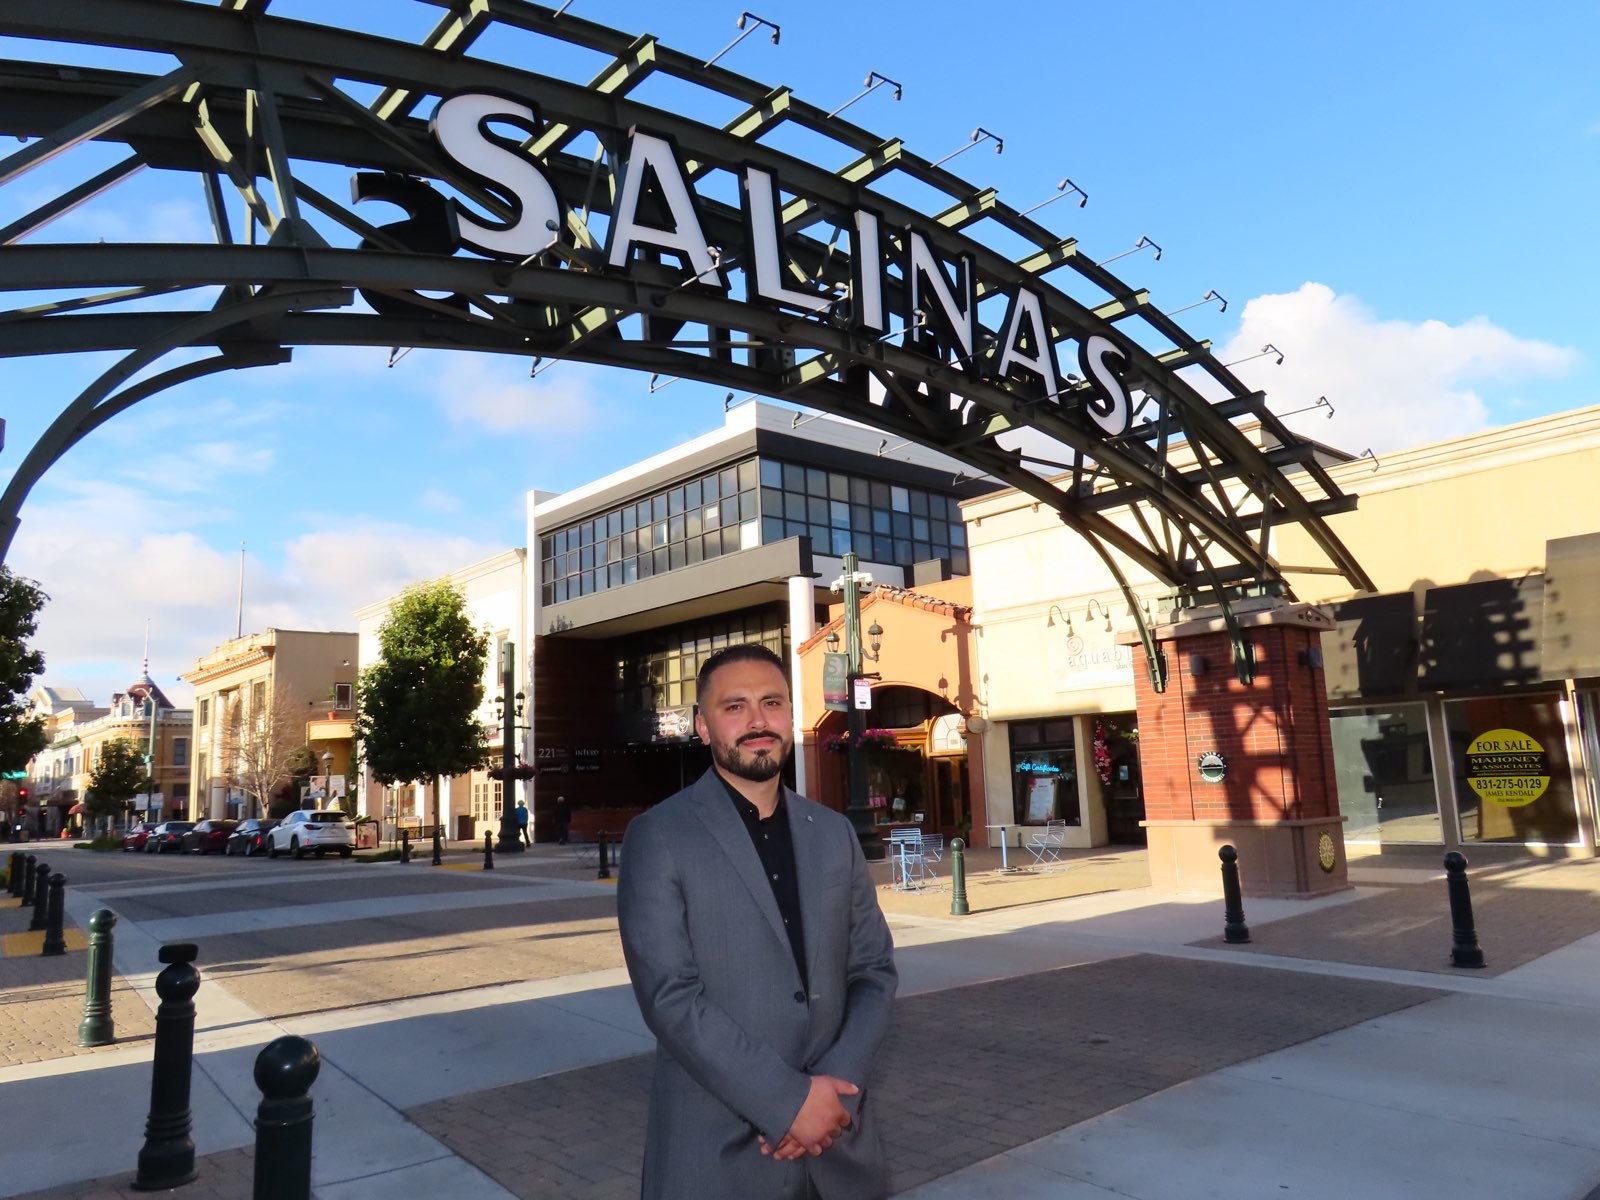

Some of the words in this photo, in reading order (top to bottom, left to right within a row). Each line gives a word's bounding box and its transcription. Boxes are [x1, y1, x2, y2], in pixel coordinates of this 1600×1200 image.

[428, 92, 1131, 437] SALINAS
[1476, 741, 1501, 751] FOR
[1504, 740, 1532, 751] SALE
[538, 748, 555, 758] 221
[1471, 756, 1541, 764] MAHONEY
[1020, 762, 1031, 771] Gift
[1032, 763, 1060, 772] Certificates
[1476, 778, 1542, 789] 831-275-0129
